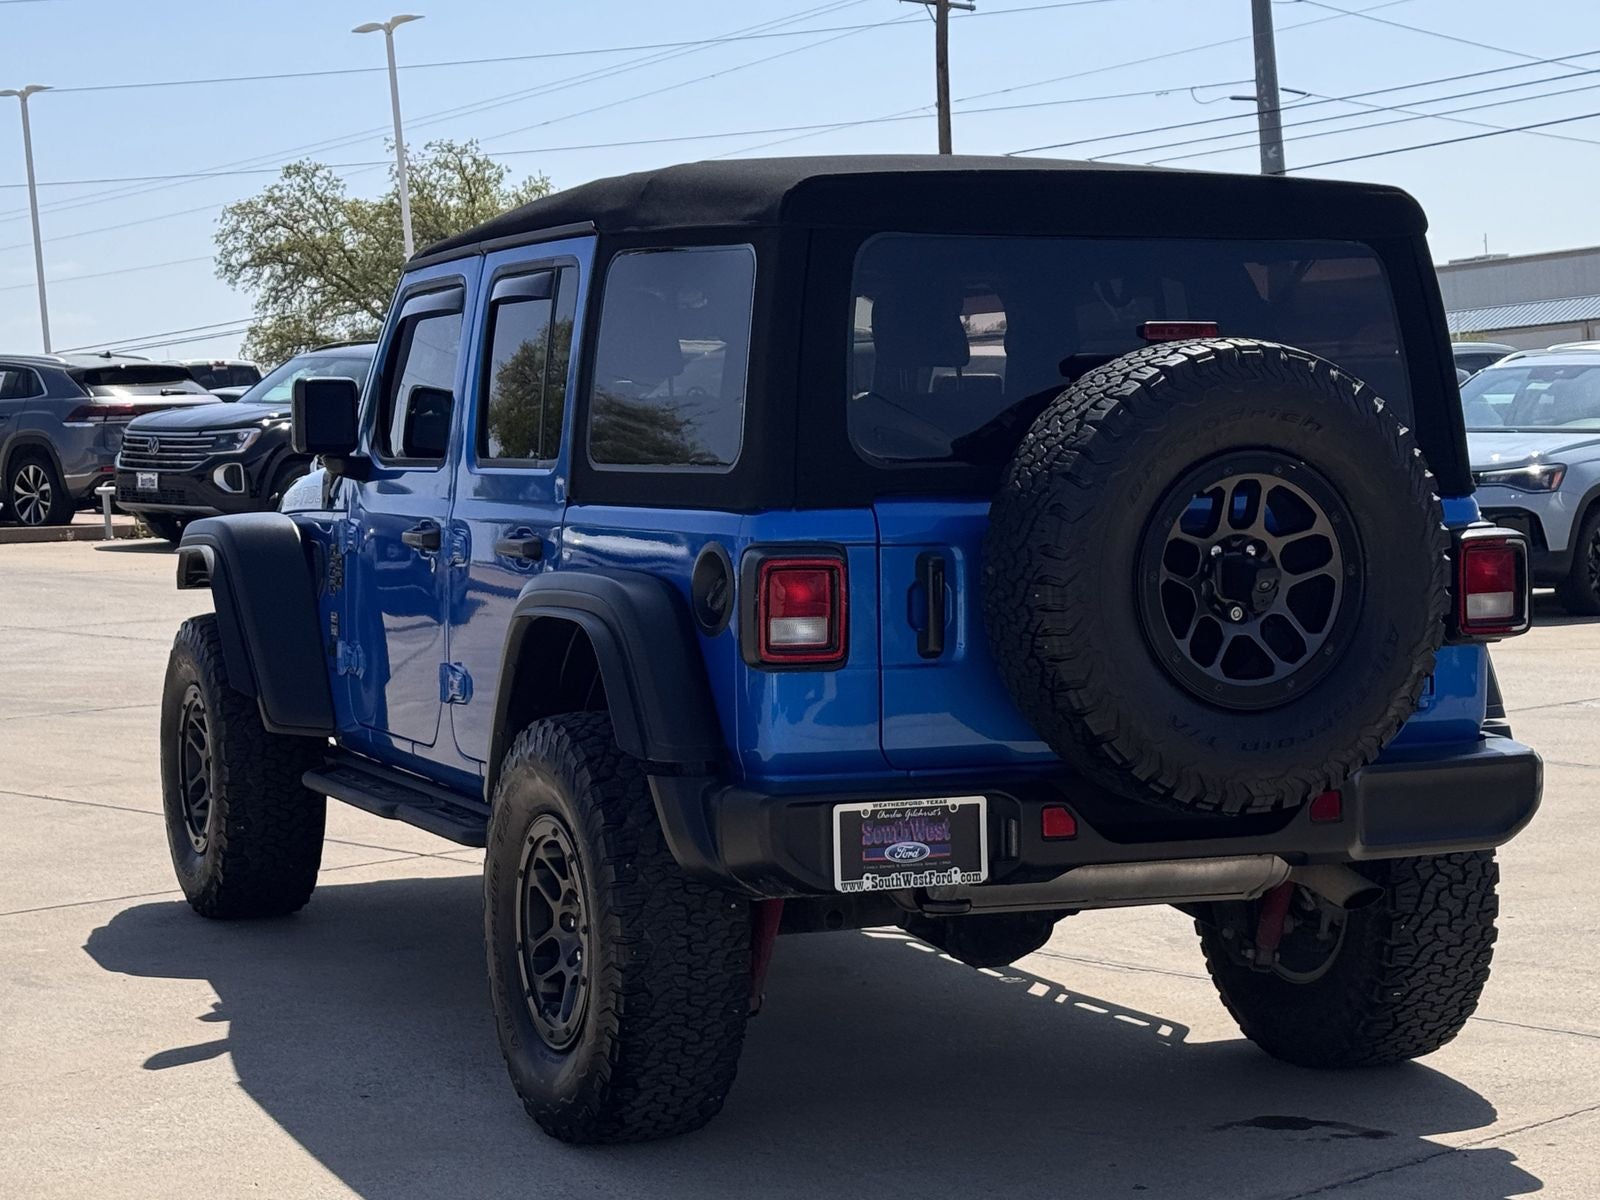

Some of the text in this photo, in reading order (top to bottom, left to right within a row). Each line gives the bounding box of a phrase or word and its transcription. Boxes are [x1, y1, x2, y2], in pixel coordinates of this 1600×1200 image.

[862, 817, 951, 846] SouthWest
[894, 845, 920, 859] Ford
[840, 870, 982, 892] www.SouthWestFord.com
